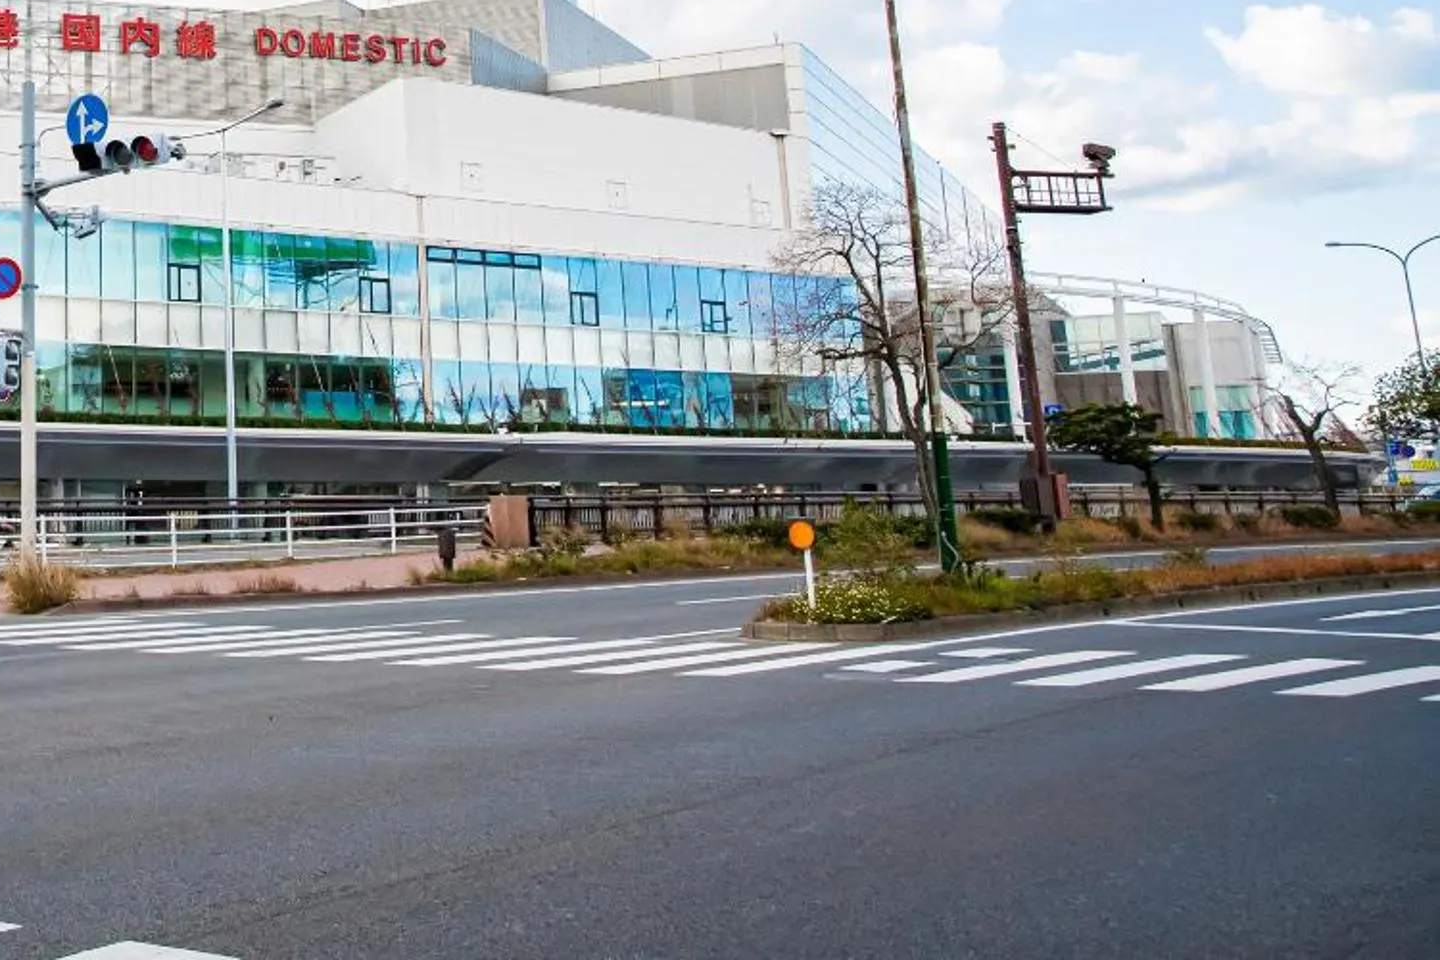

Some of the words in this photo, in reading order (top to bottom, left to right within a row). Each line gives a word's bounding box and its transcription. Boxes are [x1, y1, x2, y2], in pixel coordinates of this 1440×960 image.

[61, 12, 218, 60] 国内線
[255, 26, 447, 67] DOMESTIC
